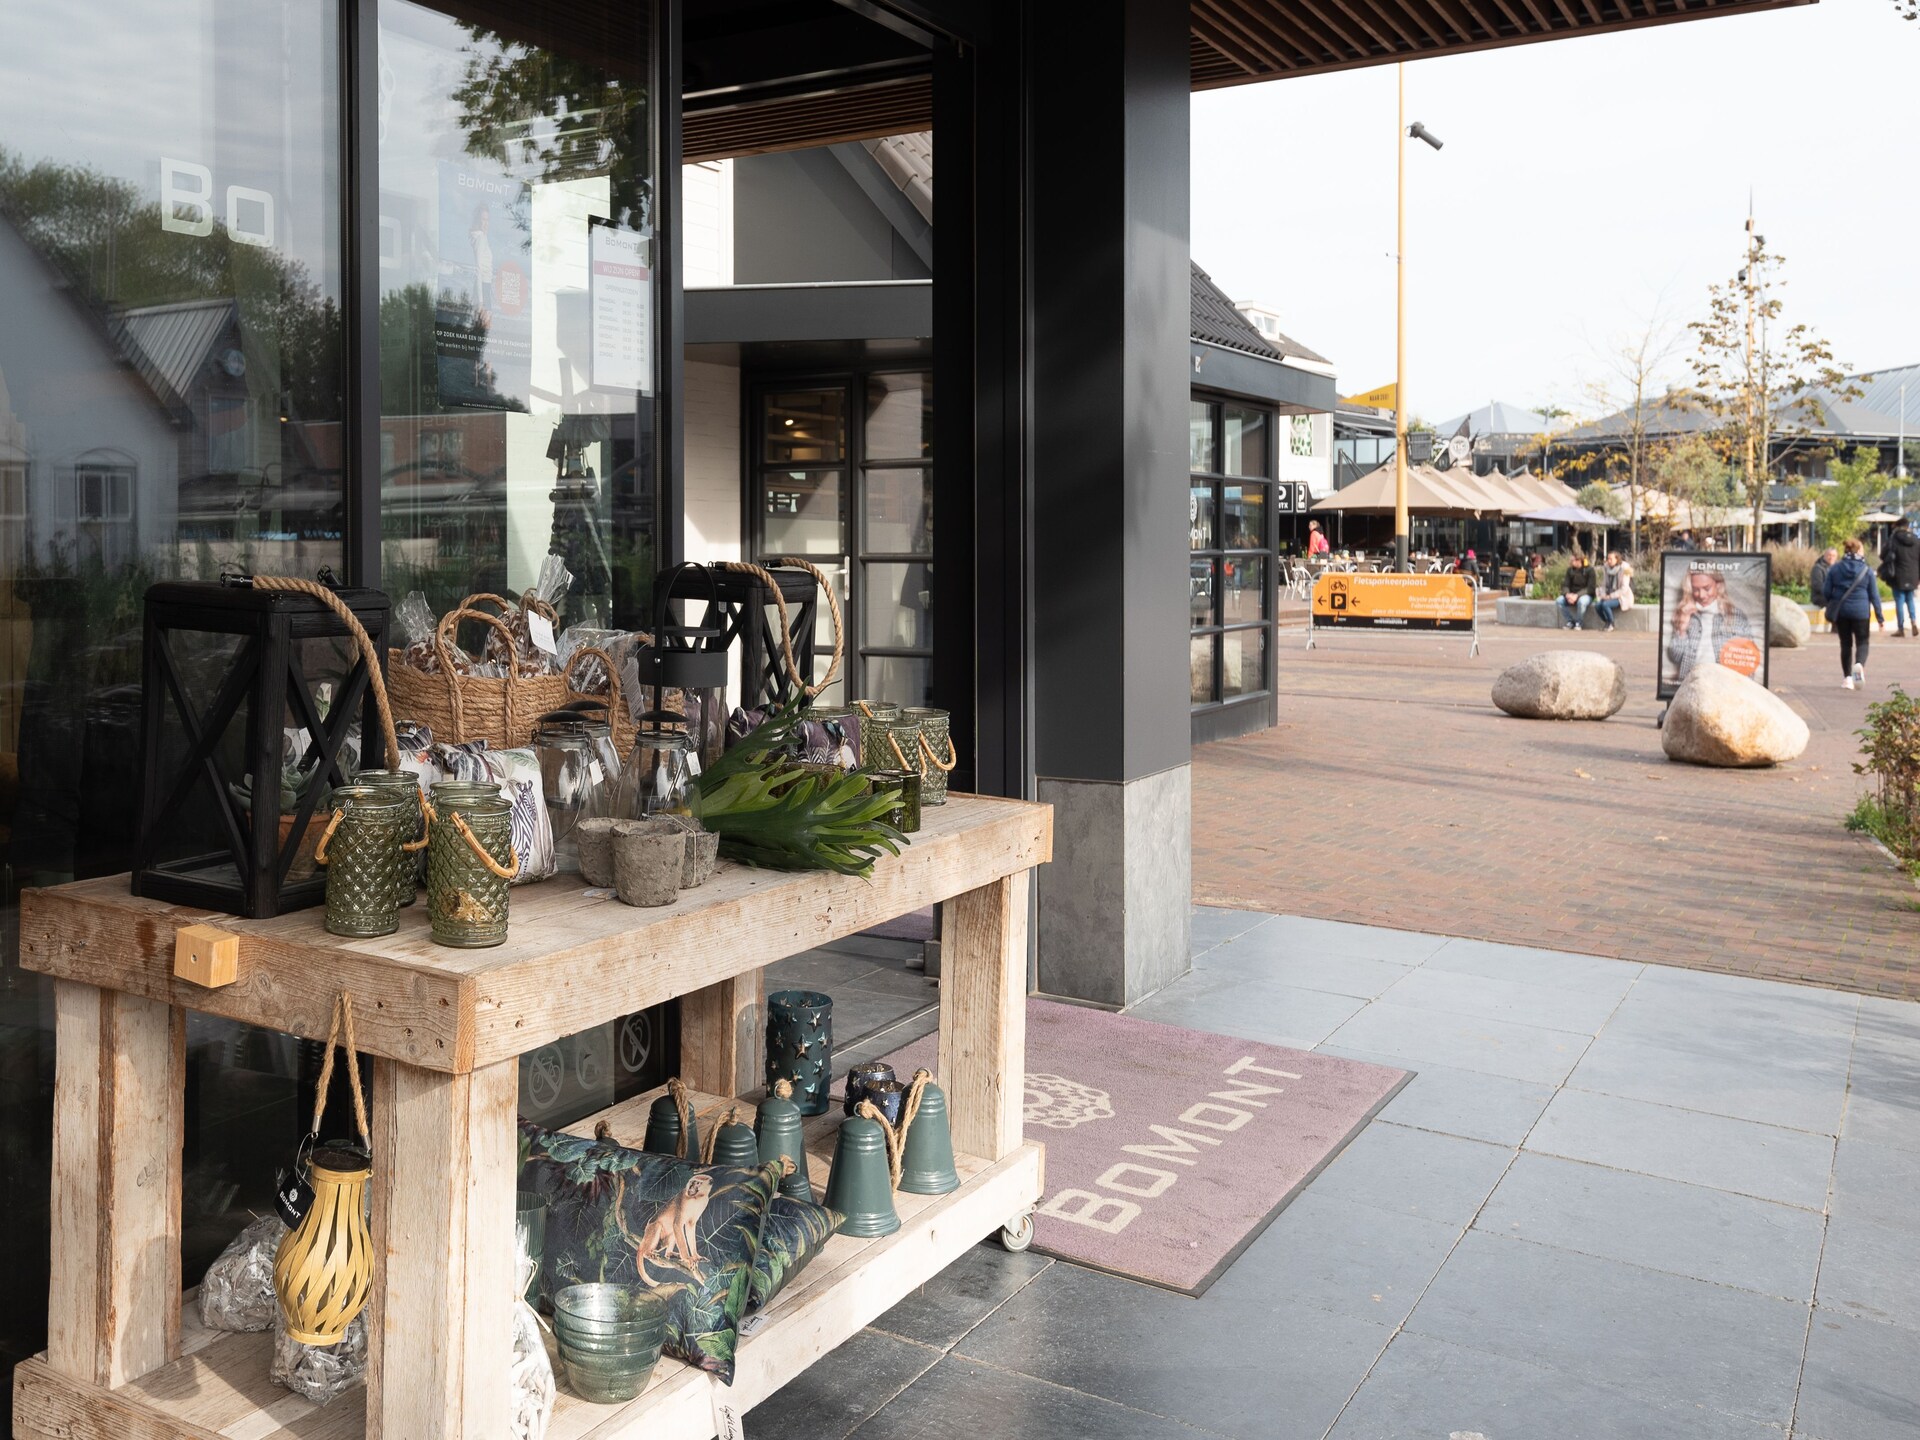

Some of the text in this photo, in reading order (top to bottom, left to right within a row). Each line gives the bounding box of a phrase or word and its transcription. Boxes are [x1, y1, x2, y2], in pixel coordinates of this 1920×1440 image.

[1690, 562, 1741, 571] BOMONT
[1353, 576, 1427, 588] Fietsparkeerplaats
[1036, 1056, 1303, 1235] BOMONT
[279, 1191, 301, 1219] BOMONT
